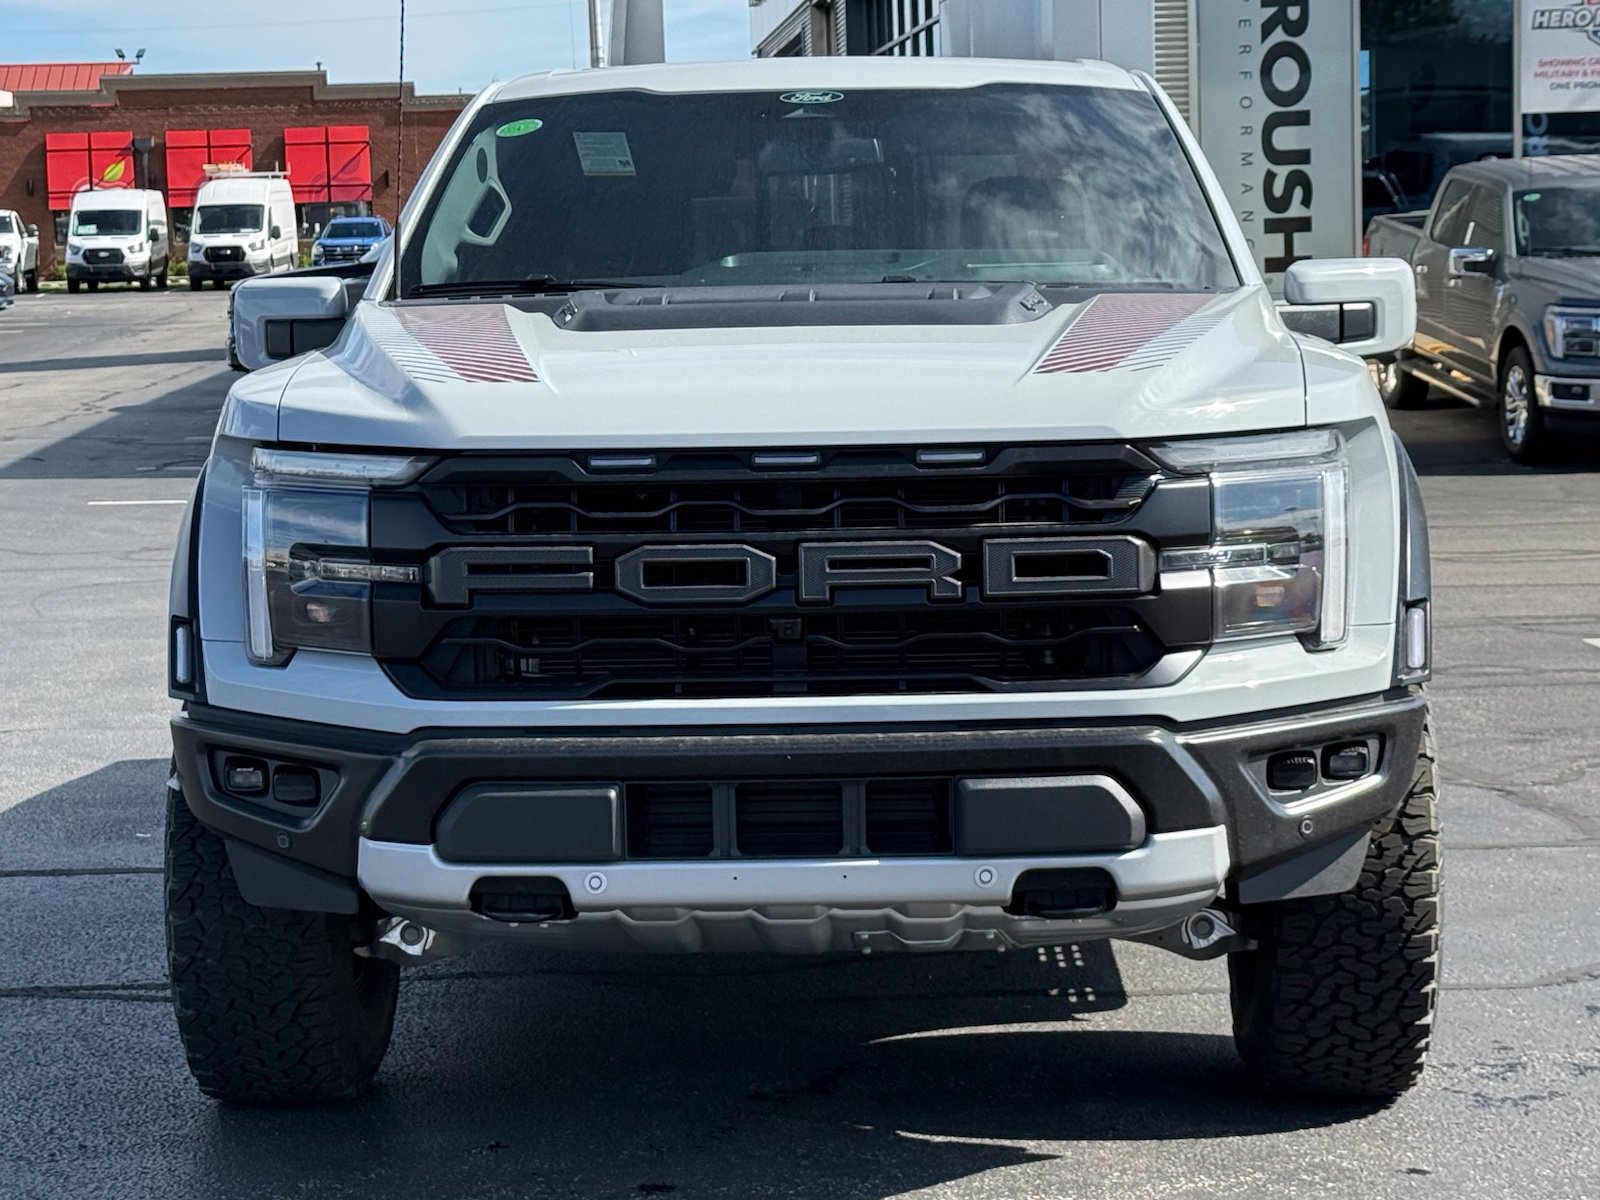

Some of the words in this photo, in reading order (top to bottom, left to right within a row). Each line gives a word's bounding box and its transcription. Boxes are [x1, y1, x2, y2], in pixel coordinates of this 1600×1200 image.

[1534, 69, 1580, 79] MILITARY
[788, 91, 834, 102] Ford
[1260, 0, 1313, 274] ROUSH
[428, 535, 1156, 604] FORD
